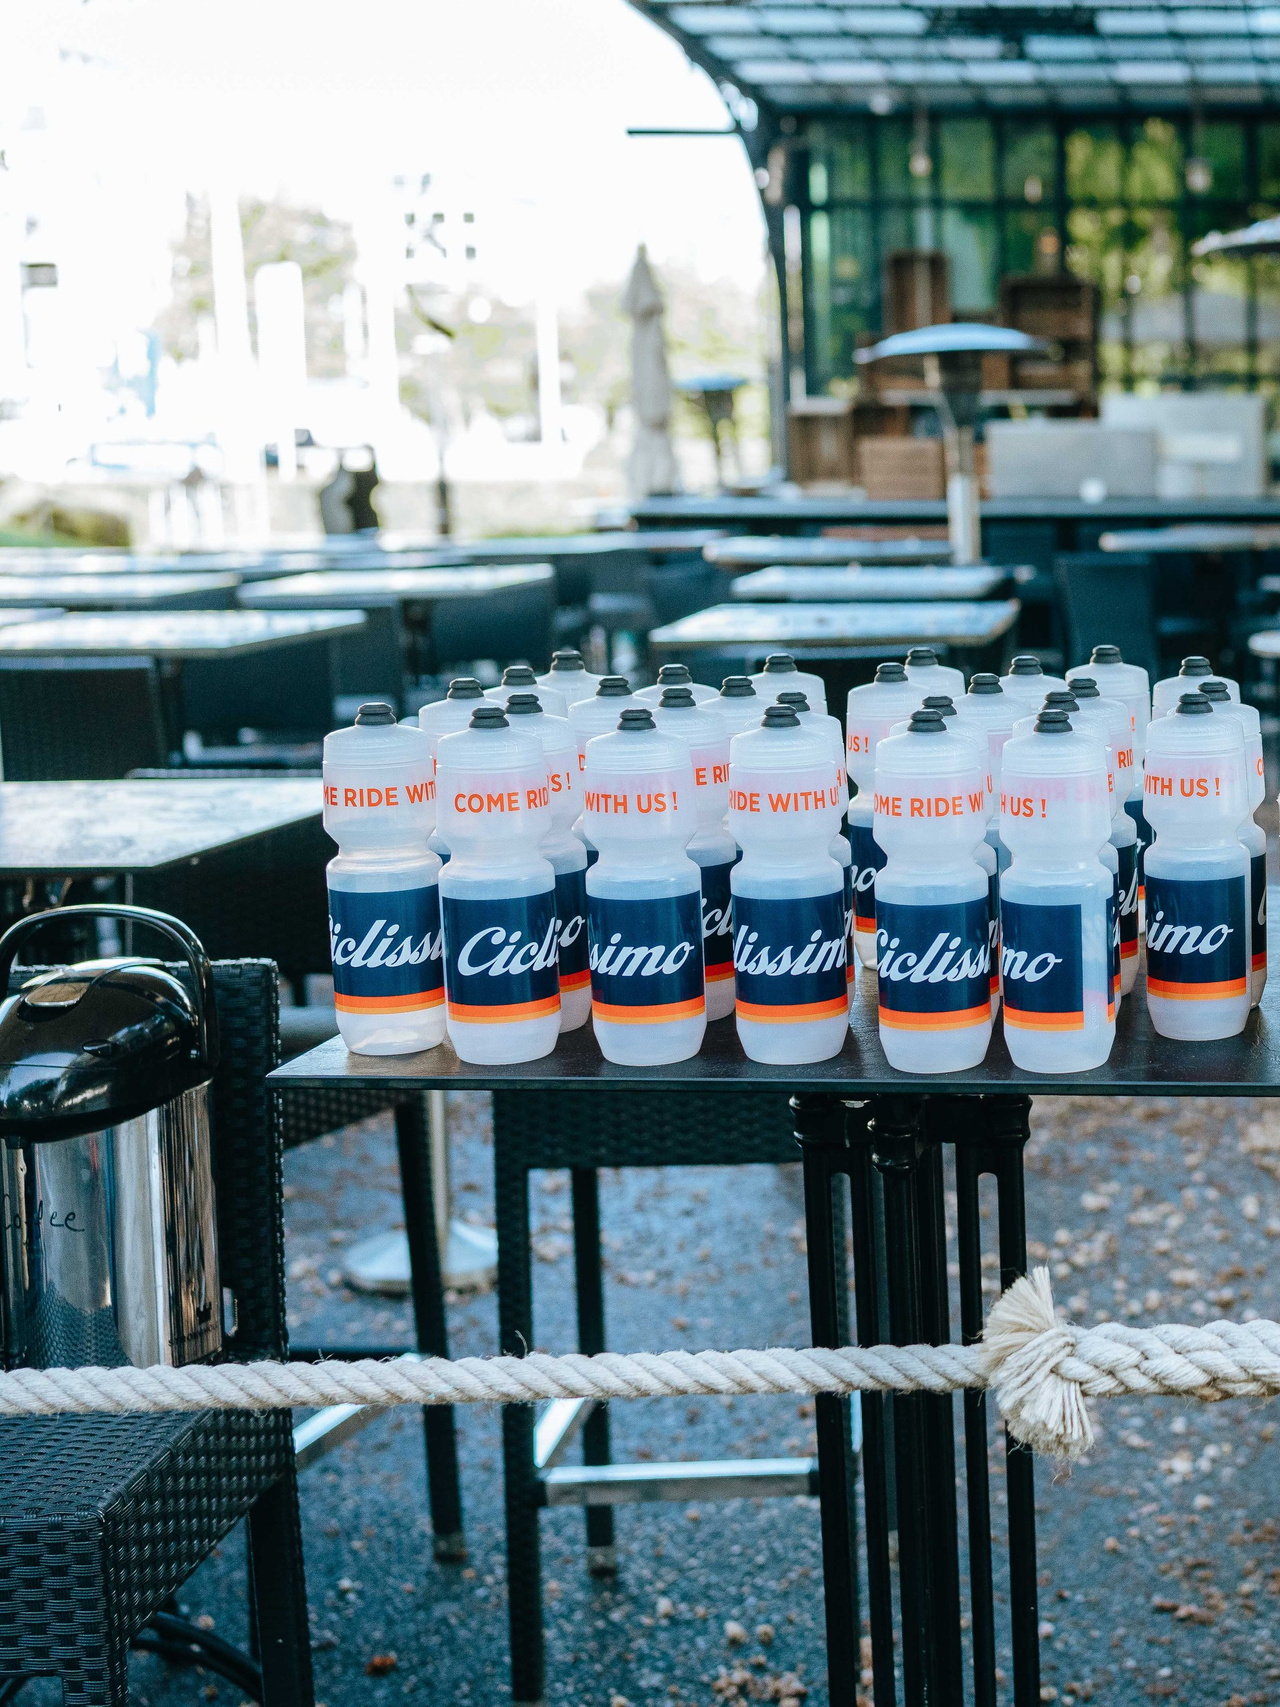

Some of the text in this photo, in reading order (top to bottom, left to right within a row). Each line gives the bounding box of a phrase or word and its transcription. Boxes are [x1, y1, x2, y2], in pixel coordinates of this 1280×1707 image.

[345, 786, 399, 807] RIDE
[1180, 778, 1209, 798] US
[454, 792, 520, 813] COME
[636, 793, 667, 814] US
[768, 790, 826, 813] WITH
[910, 795, 964, 818] RIDE
[1010, 797, 1034, 818] US
